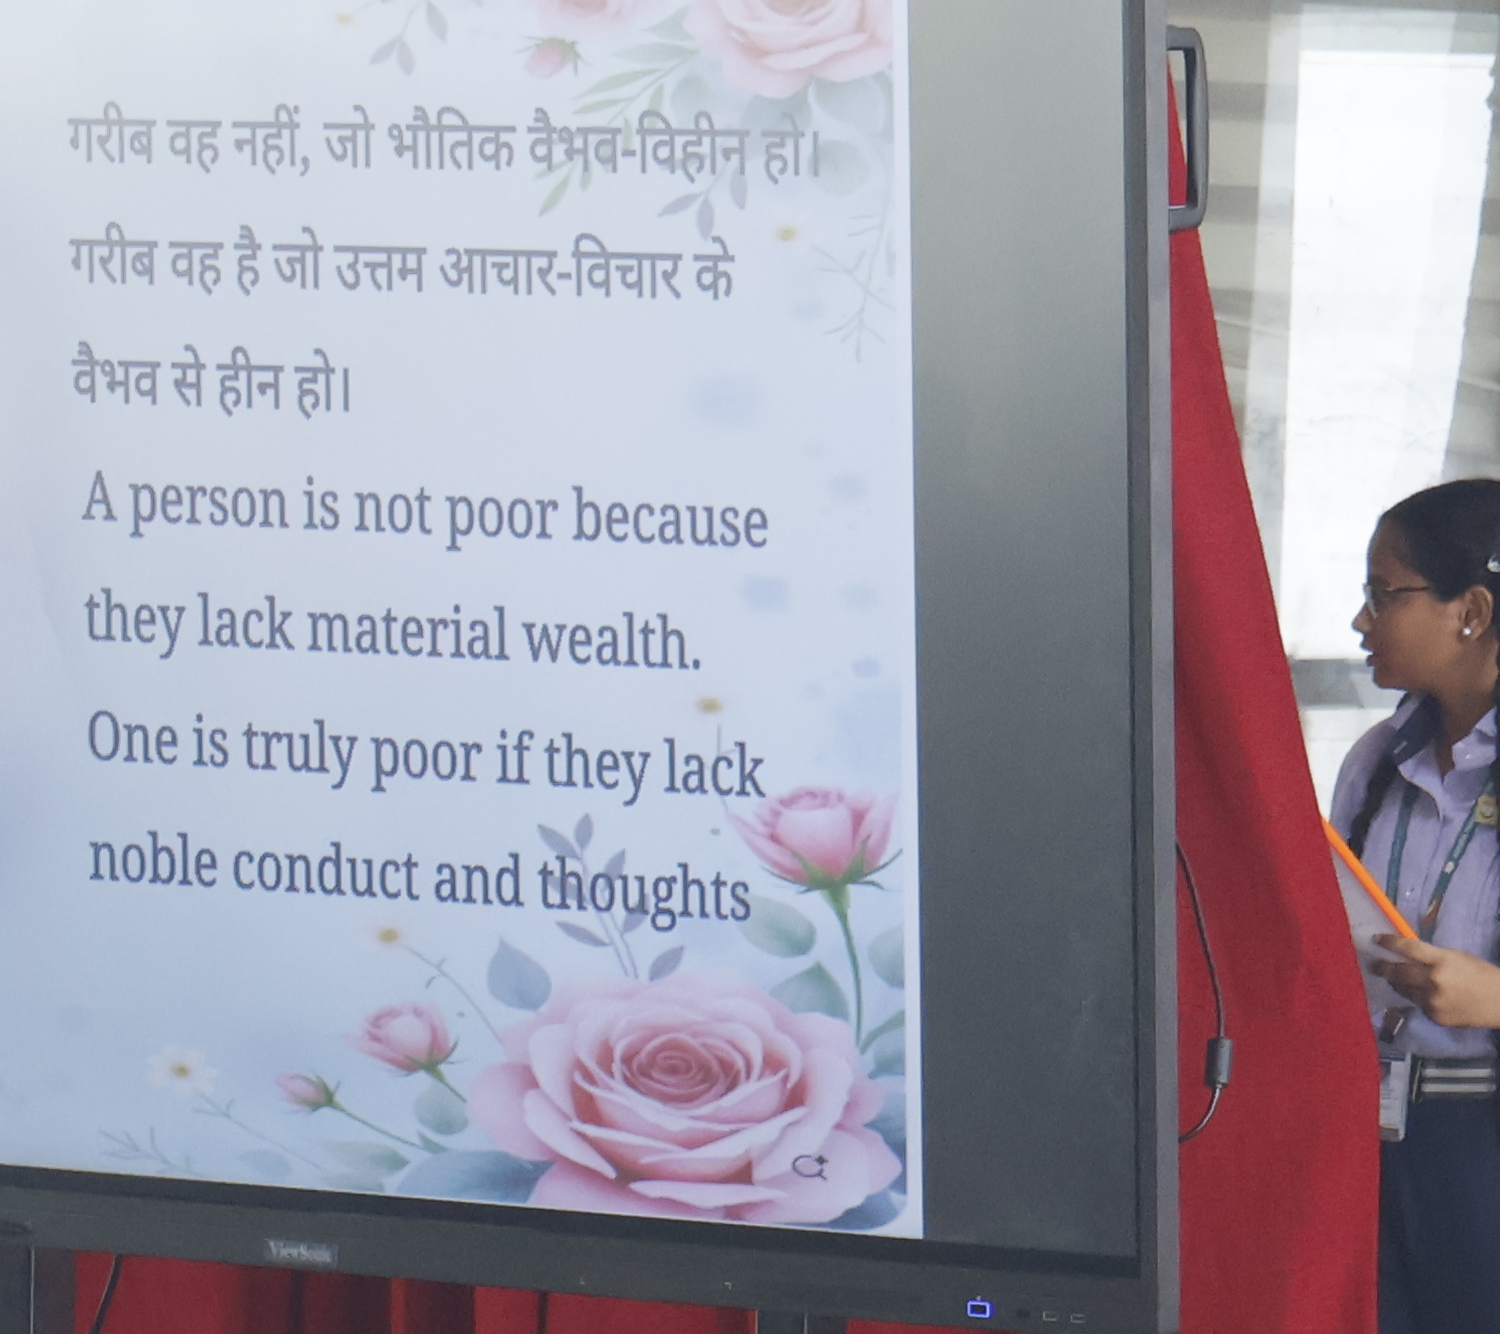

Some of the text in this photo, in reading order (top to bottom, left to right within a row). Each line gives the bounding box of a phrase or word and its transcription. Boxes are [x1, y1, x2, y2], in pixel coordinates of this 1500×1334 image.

[67, 101, 820, 184] गरीब वह नहीं, जो भौतिक वैभव-विहीन हो।
[69, 221, 735, 301] गरीब वह है जो उत्तम आचार-विचार के
[72, 341, 350, 420] वैभव से हीन हो।
[82, 469, 769, 552] A person is not poor because
[84, 587, 701, 671] they lack material wealth.
[88, 709, 766, 807] One is truly poor if they lack
[89, 829, 752, 933] noble conduct and thoughts
